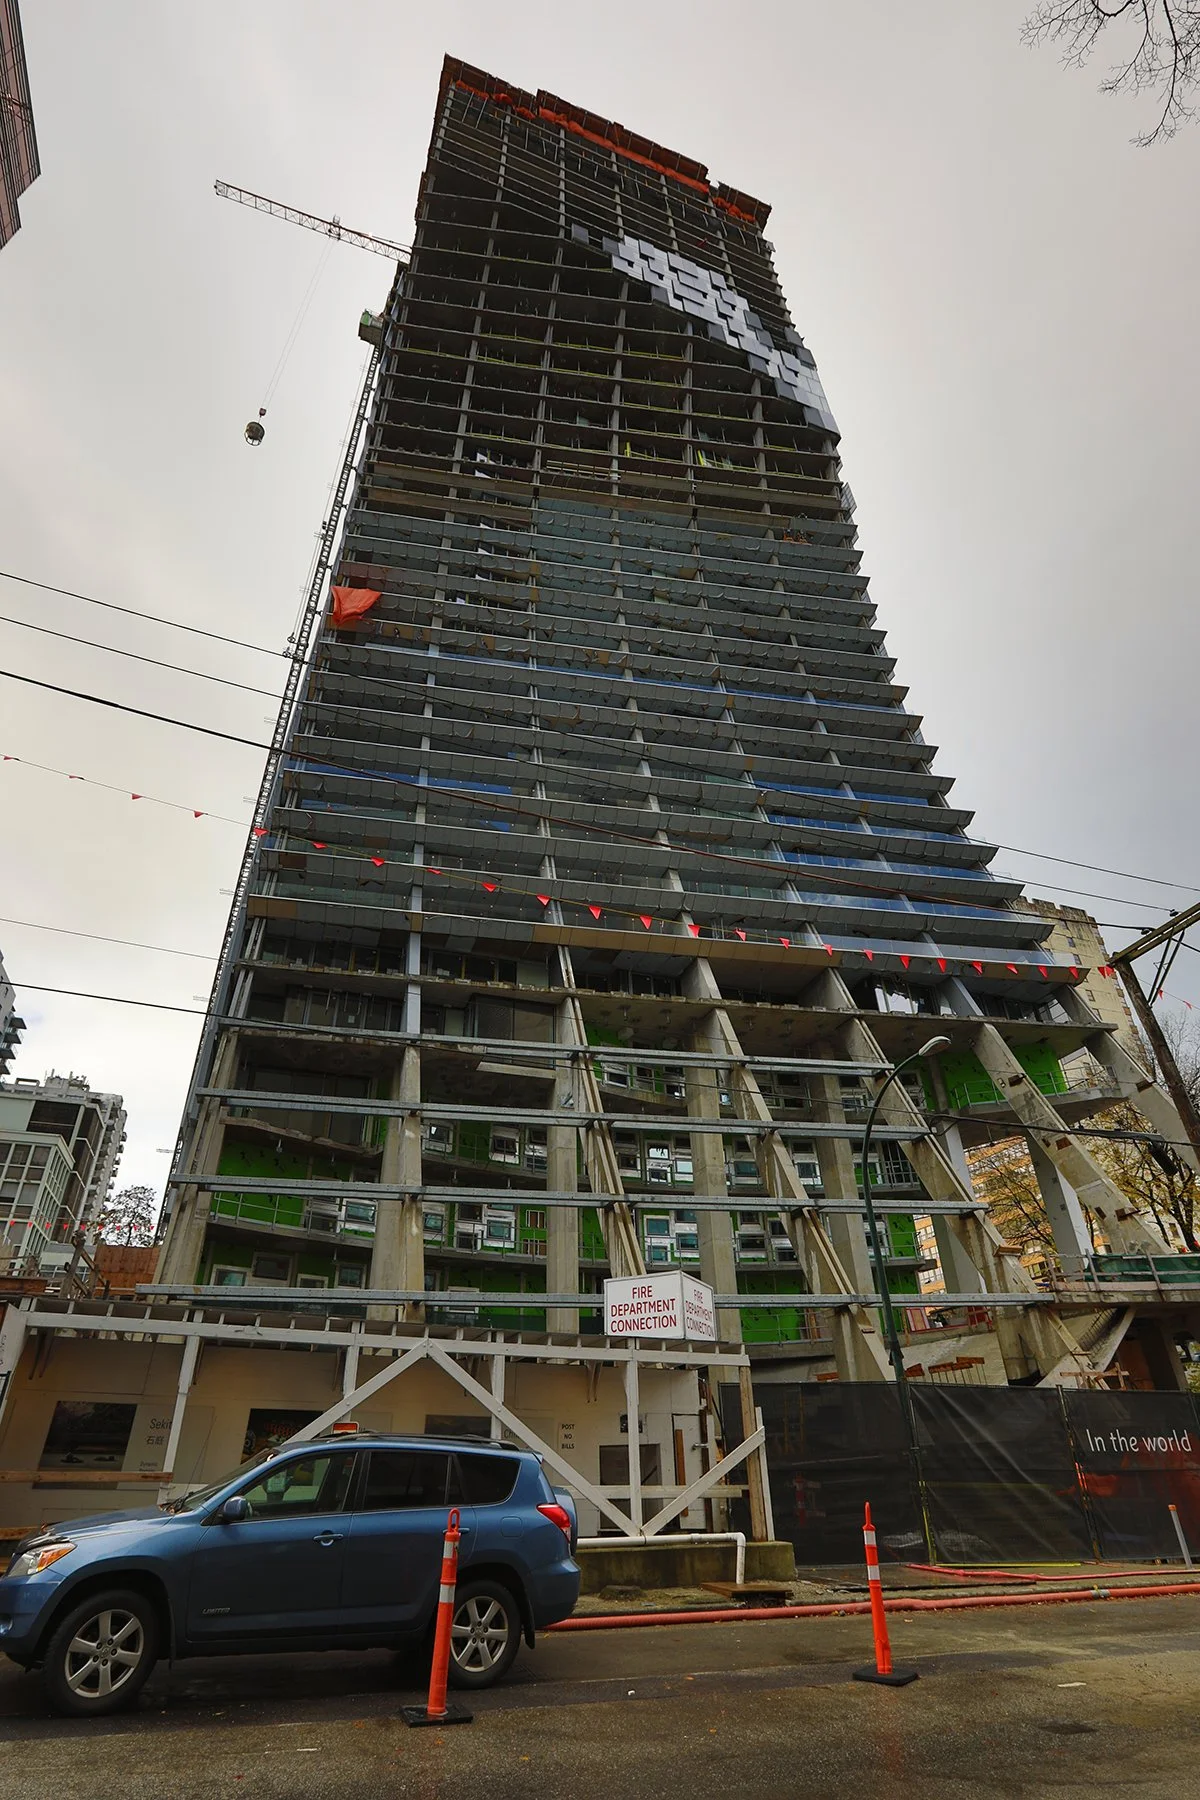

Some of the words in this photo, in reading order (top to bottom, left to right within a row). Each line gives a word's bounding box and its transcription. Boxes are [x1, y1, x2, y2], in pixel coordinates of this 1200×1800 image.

[632, 1286, 653, 1299] FIRE
[694, 1289, 704, 1303] FIRE
[611, 1299, 676, 1317] DEPARTMENT
[685, 1300, 713, 1321] DEPARTMENT
[610, 1315, 677, 1333] CONNECTION
[686, 1317, 715, 1337] CONNECTION
[1086, 1428, 1106, 1452] In
[1110, 1429, 1139, 1452] the
[1142, 1429, 1192, 1452] world
